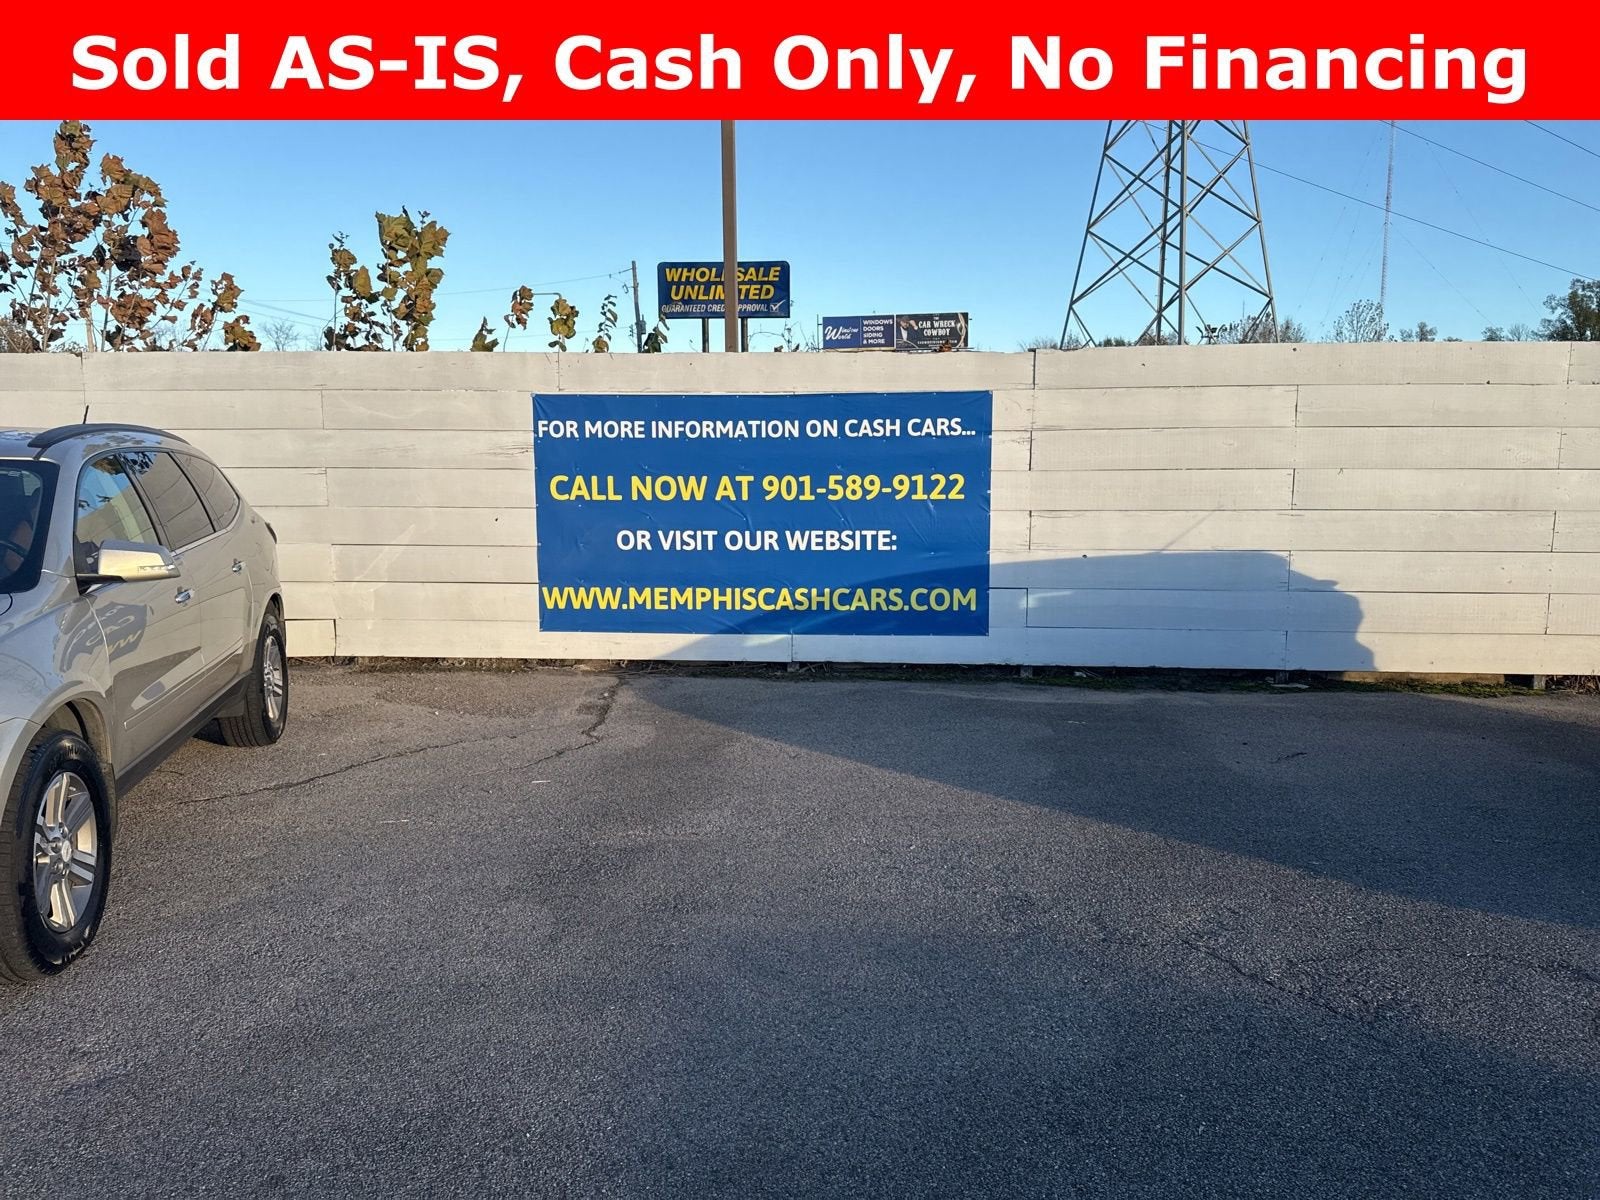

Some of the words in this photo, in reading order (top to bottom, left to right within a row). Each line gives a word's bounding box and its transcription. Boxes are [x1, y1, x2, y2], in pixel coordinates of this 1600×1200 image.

[665, 266, 781, 282] WHOLSALE
[671, 285, 775, 300] UNLIMTED
[661, 304, 706, 313] GUARANTEED
[707, 304, 726, 312] CRED
[737, 304, 768, 312] PPROVAL
[918, 320, 931, 328] CAR
[933, 320, 956, 328] WRECK
[537, 420, 578, 439] FOR
[584, 420, 645, 439] MORE
[651, 419, 799, 438] INFORMATION
[806, 419, 838, 438] ON
[845, 418, 900, 438] CASH
[907, 417, 976, 437] CARS...
[549, 475, 622, 501] CALL
[631, 475, 707, 501] NOW
[715, 475, 754, 500] AT
[762, 473, 965, 501] 901-589-9122
[616, 530, 652, 551] OR
[657, 530, 718, 550] VISIT
[724, 530, 780, 551] OUR
[785, 529, 897, 551] WEBSITE:
[542, 587, 977, 611] WWW.MEMPHISCASHCARS.COM
